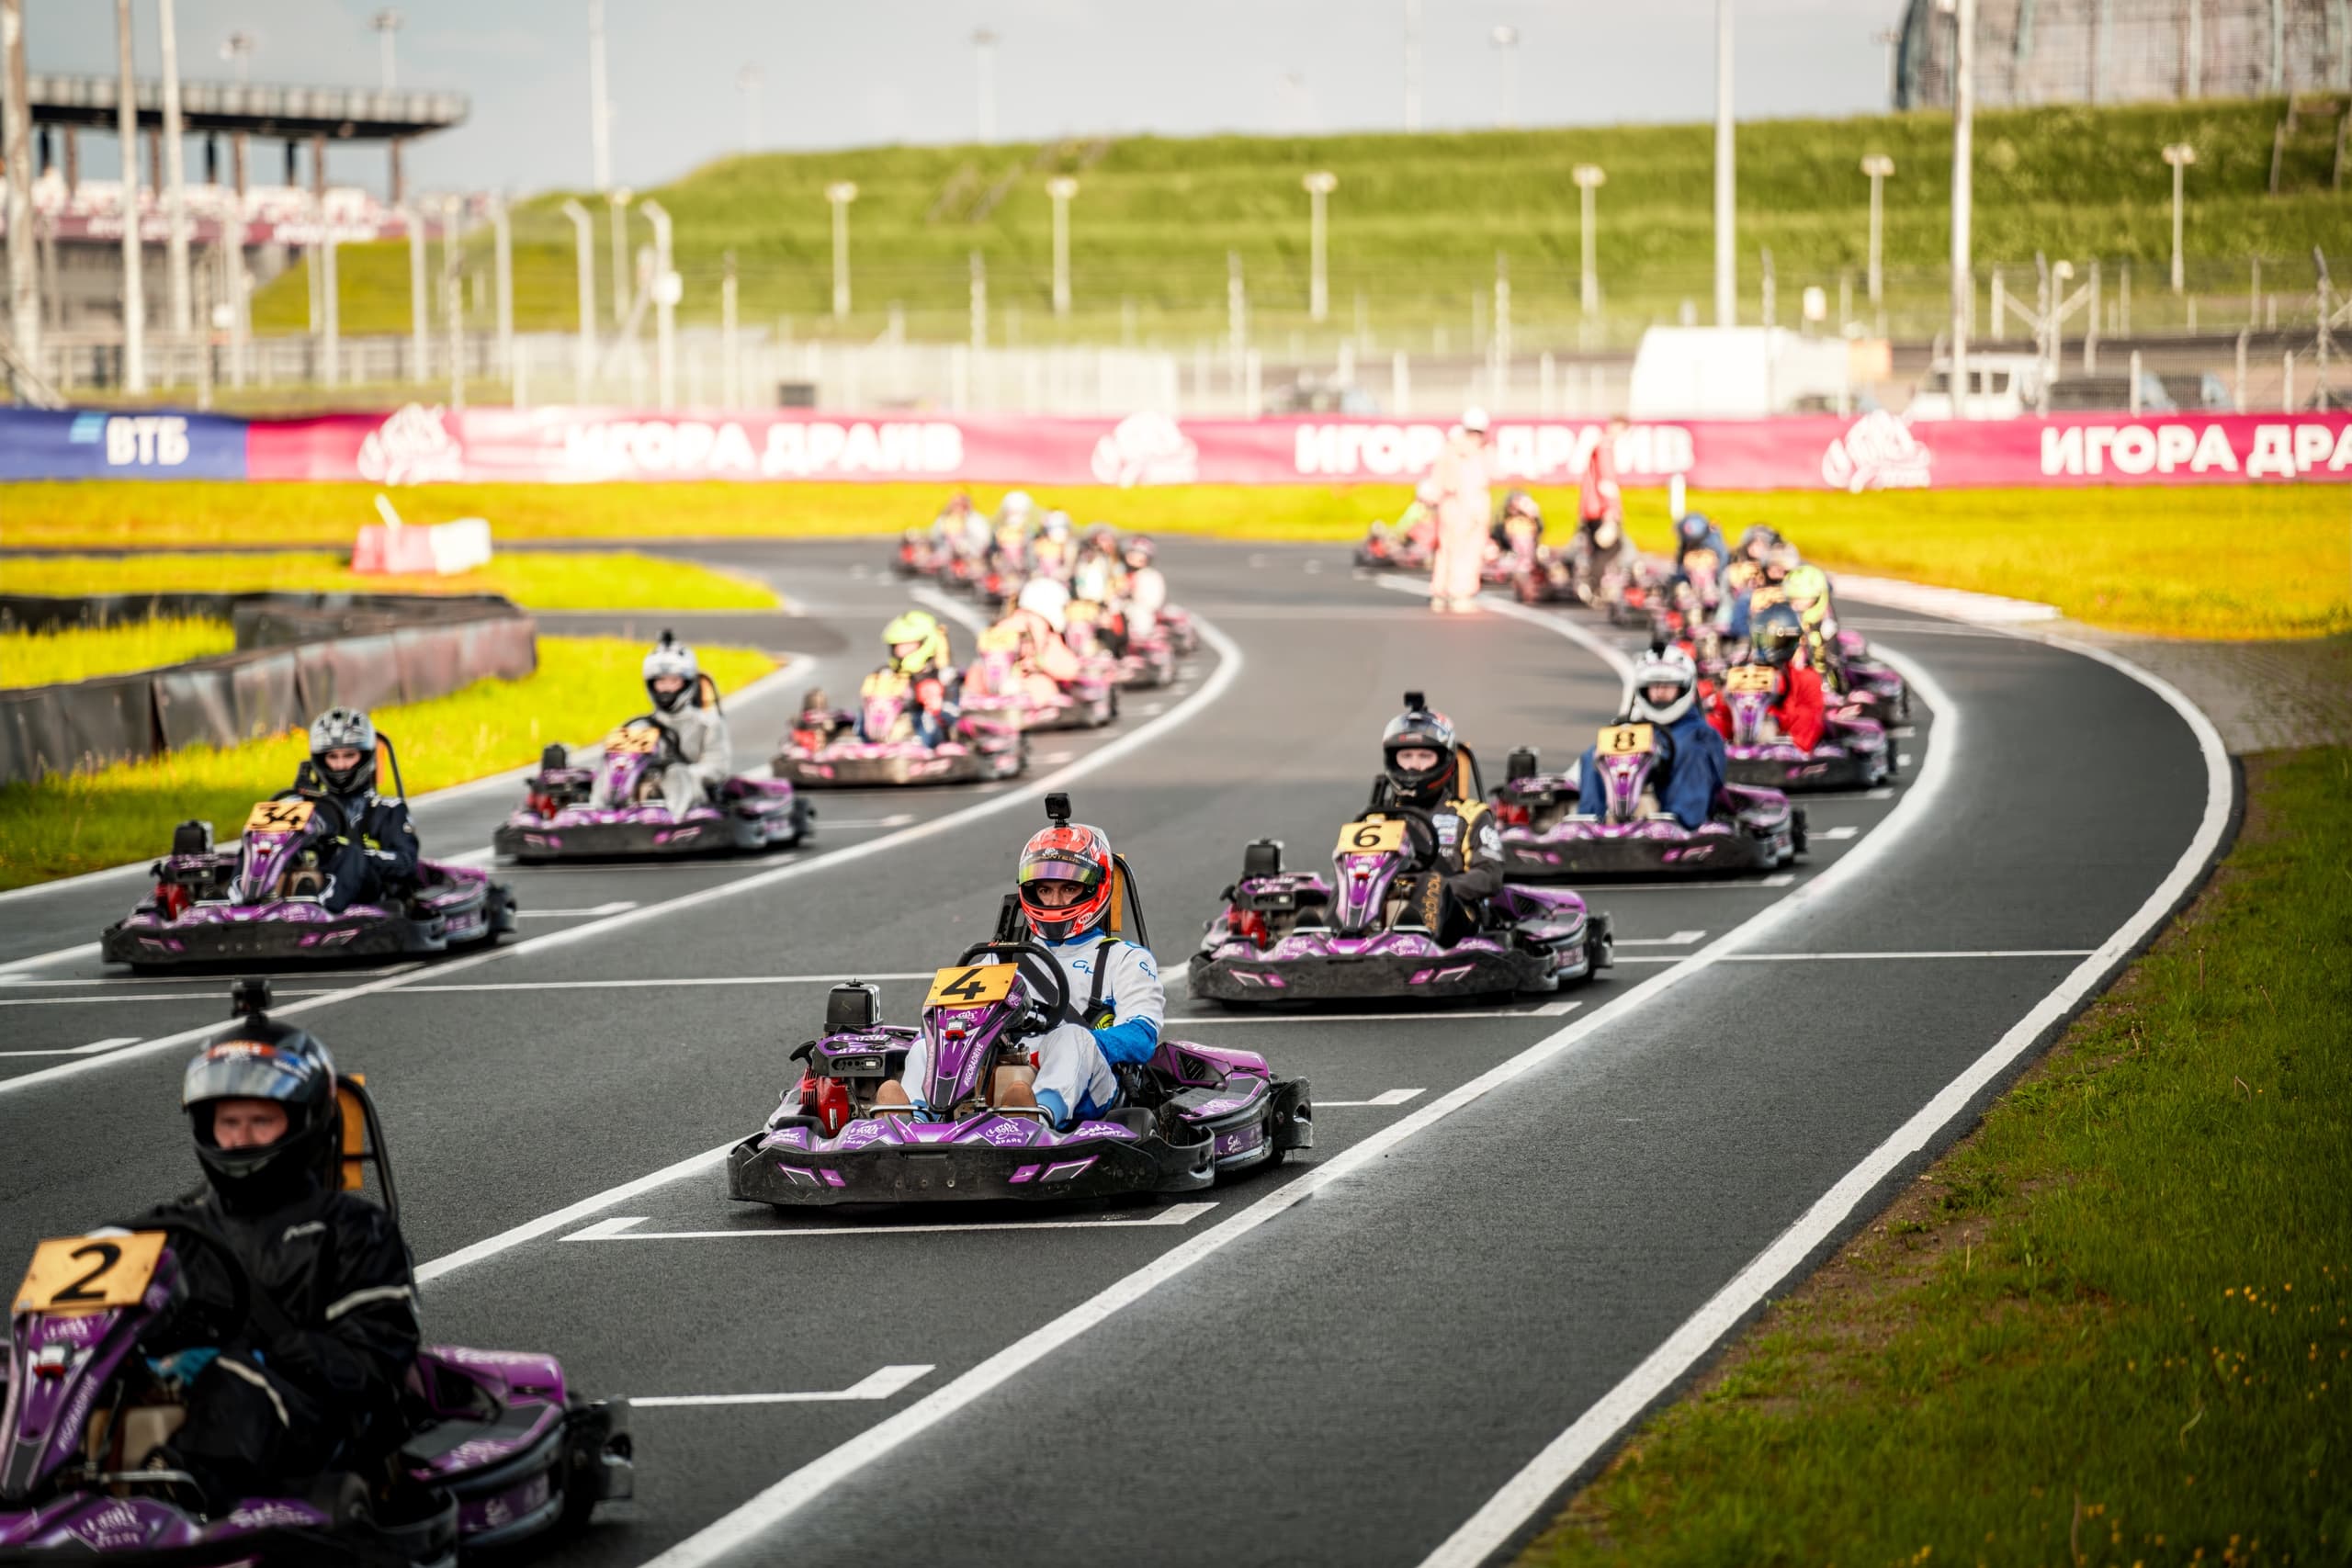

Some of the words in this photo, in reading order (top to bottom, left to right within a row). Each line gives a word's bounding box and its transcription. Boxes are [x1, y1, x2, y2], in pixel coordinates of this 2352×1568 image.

[107, 416, 189, 465] ВТБ
[1295, 423, 1448, 474] ИГОР
[2041, 424, 2238, 476] ИГОРА
[1614, 731, 1635, 751] 8
[250, 803, 306, 829] 34
[1353, 825, 1382, 848] 6
[940, 967, 987, 1000] 4
[50, 1242, 121, 1304] 2
